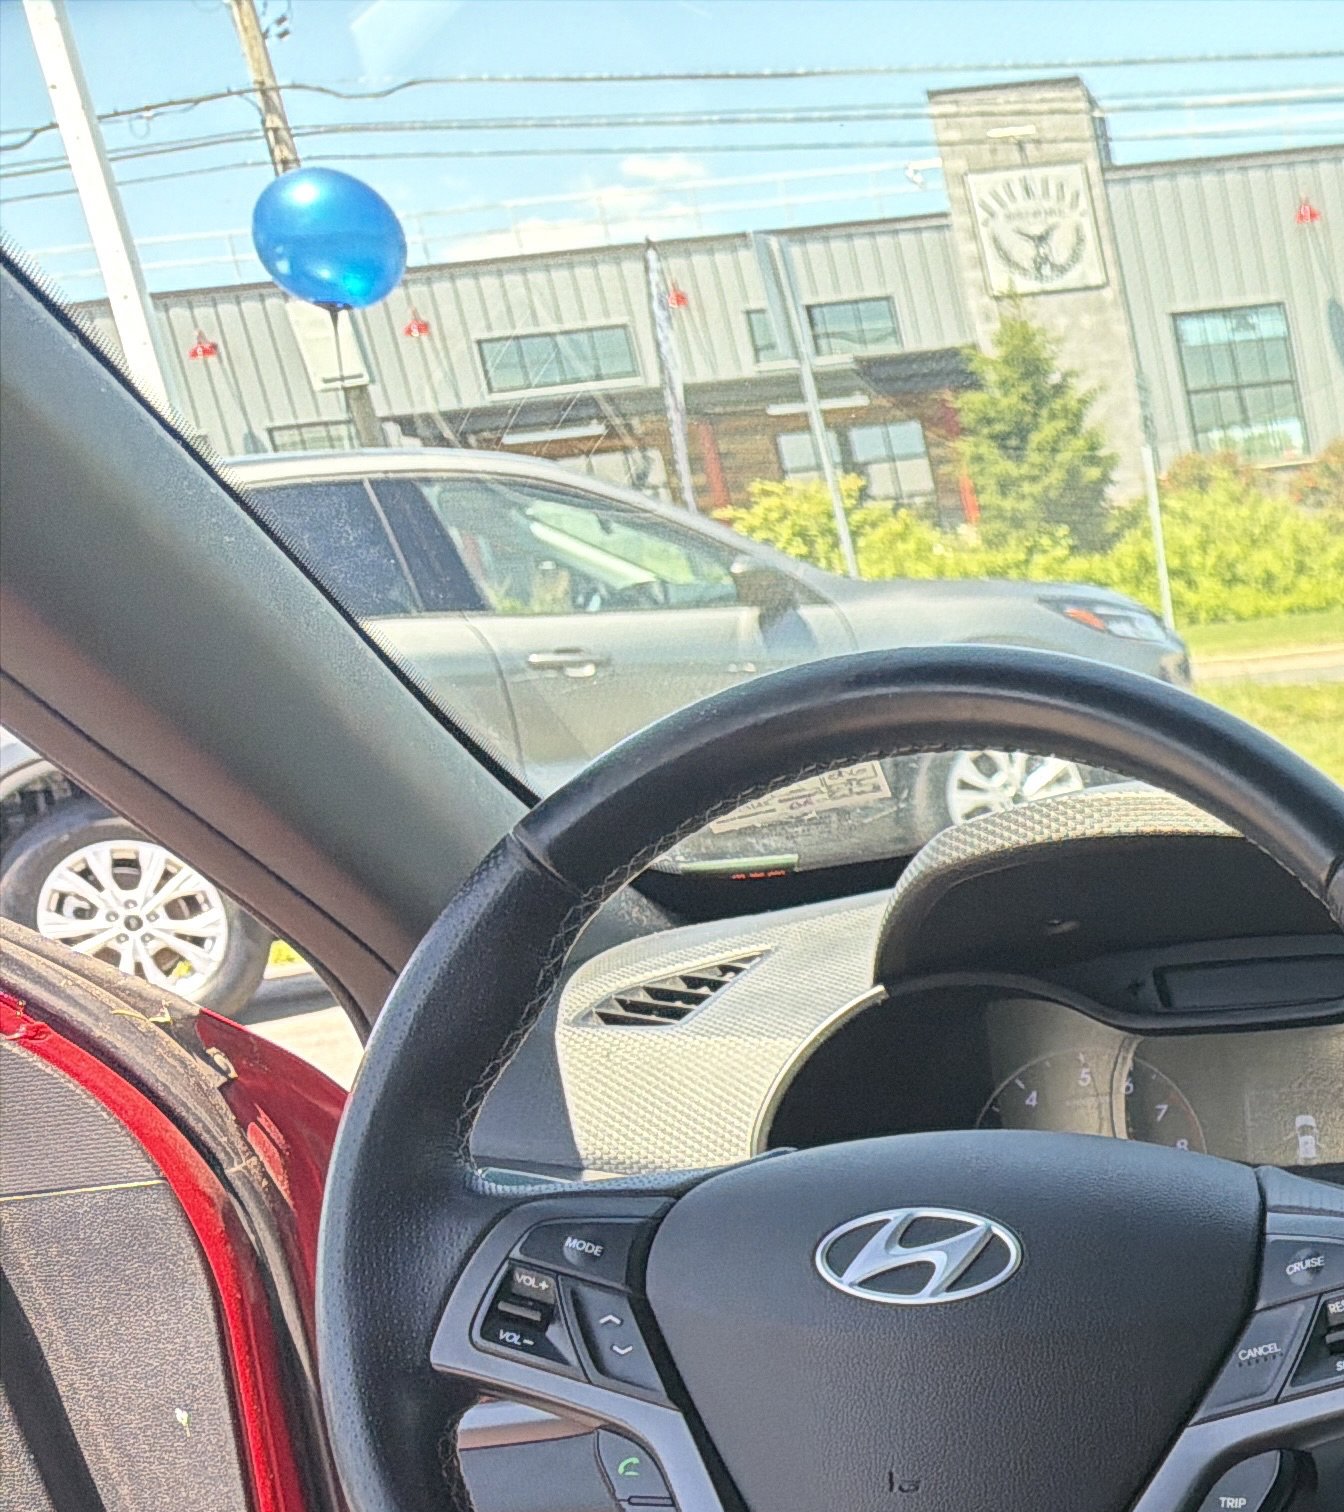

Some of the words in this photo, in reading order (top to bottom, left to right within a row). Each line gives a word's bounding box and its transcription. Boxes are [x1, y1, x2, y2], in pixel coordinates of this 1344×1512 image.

[1077, 1067, 1092, 1087] 5
[1025, 1090, 1039, 1107] 4
[1155, 1104, 1169, 1122] 7
[565, 1236, 604, 1257] MODE
[1286, 1255, 1326, 1276] CRUISE
[1238, 1342, 1282, 1361] CANCEL
[1219, 1496, 1247, 1509] TRIP
